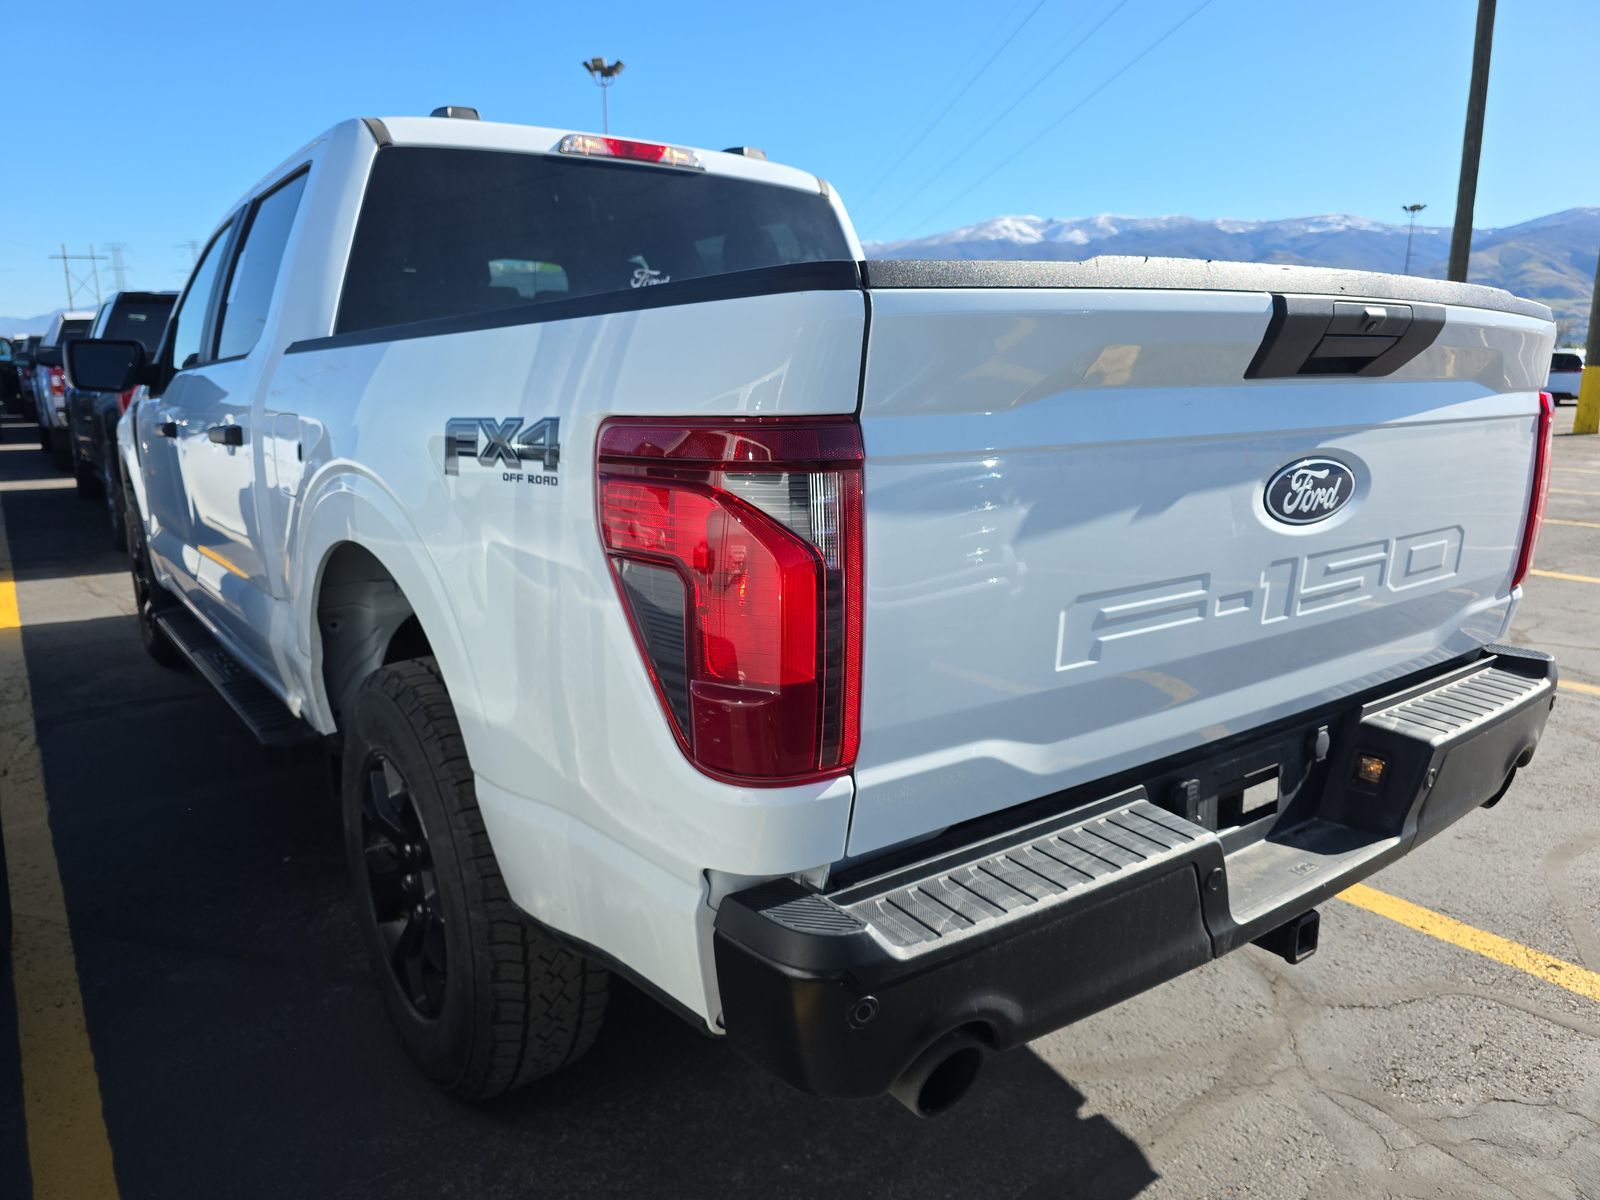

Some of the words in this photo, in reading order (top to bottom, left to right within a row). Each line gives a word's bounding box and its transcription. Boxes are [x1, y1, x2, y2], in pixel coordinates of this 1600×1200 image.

[445, 417, 560, 476] FX4
[502, 472, 524, 483] OFF
[527, 473, 558, 486] ROAD
[1282, 467, 1342, 513] Ford
[1056, 524, 1464, 671] F-150
